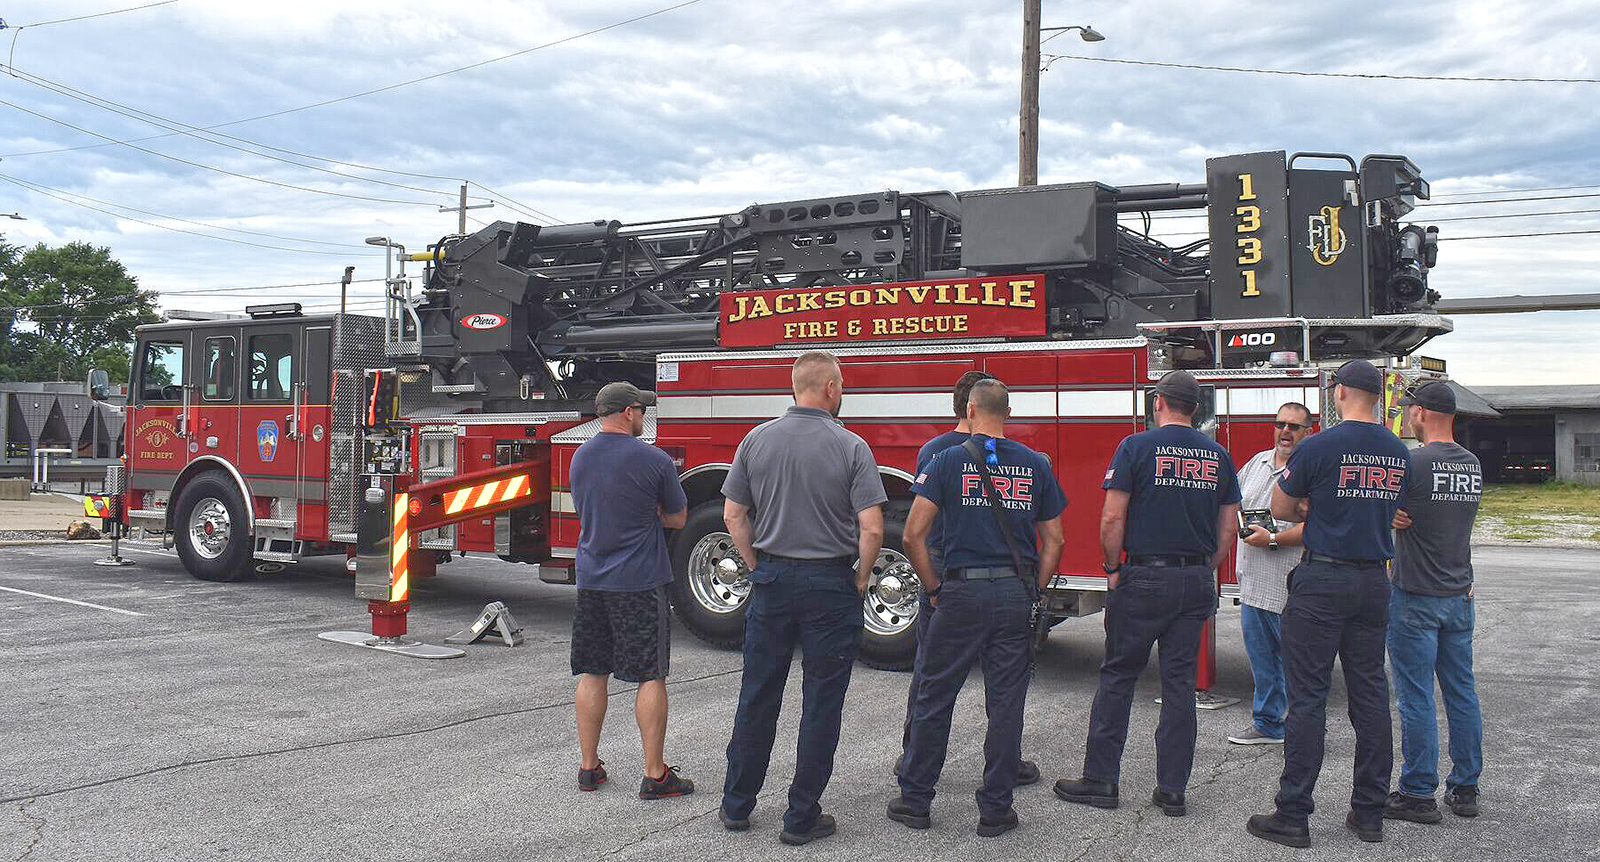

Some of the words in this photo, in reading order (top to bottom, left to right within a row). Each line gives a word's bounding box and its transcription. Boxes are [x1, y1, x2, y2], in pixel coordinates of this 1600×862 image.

[729, 280, 1036, 322] JACKSONVILLE
[471, 315, 497, 327] Pierce
[784, 320, 838, 338] FIRE
[847, 319, 862, 335] &
[873, 315, 968, 335] RESCUE
[135, 419, 179, 437] JACKSONVILL
[141, 451, 156, 459] FIRE
[1155, 446, 1219, 460] JACKSONVILLE
[1340, 453, 1407, 469] JACKSONVILLE
[1155, 456, 1219, 483] FIRE
[1154, 477, 1218, 492] DEPARTMENT
[1337, 465, 1405, 493] FIRE
[1432, 472, 1482, 494] FIRE
[1336, 489, 1399, 501] DEPARTMENT
[961, 497, 1033, 511] DEPAMENT
